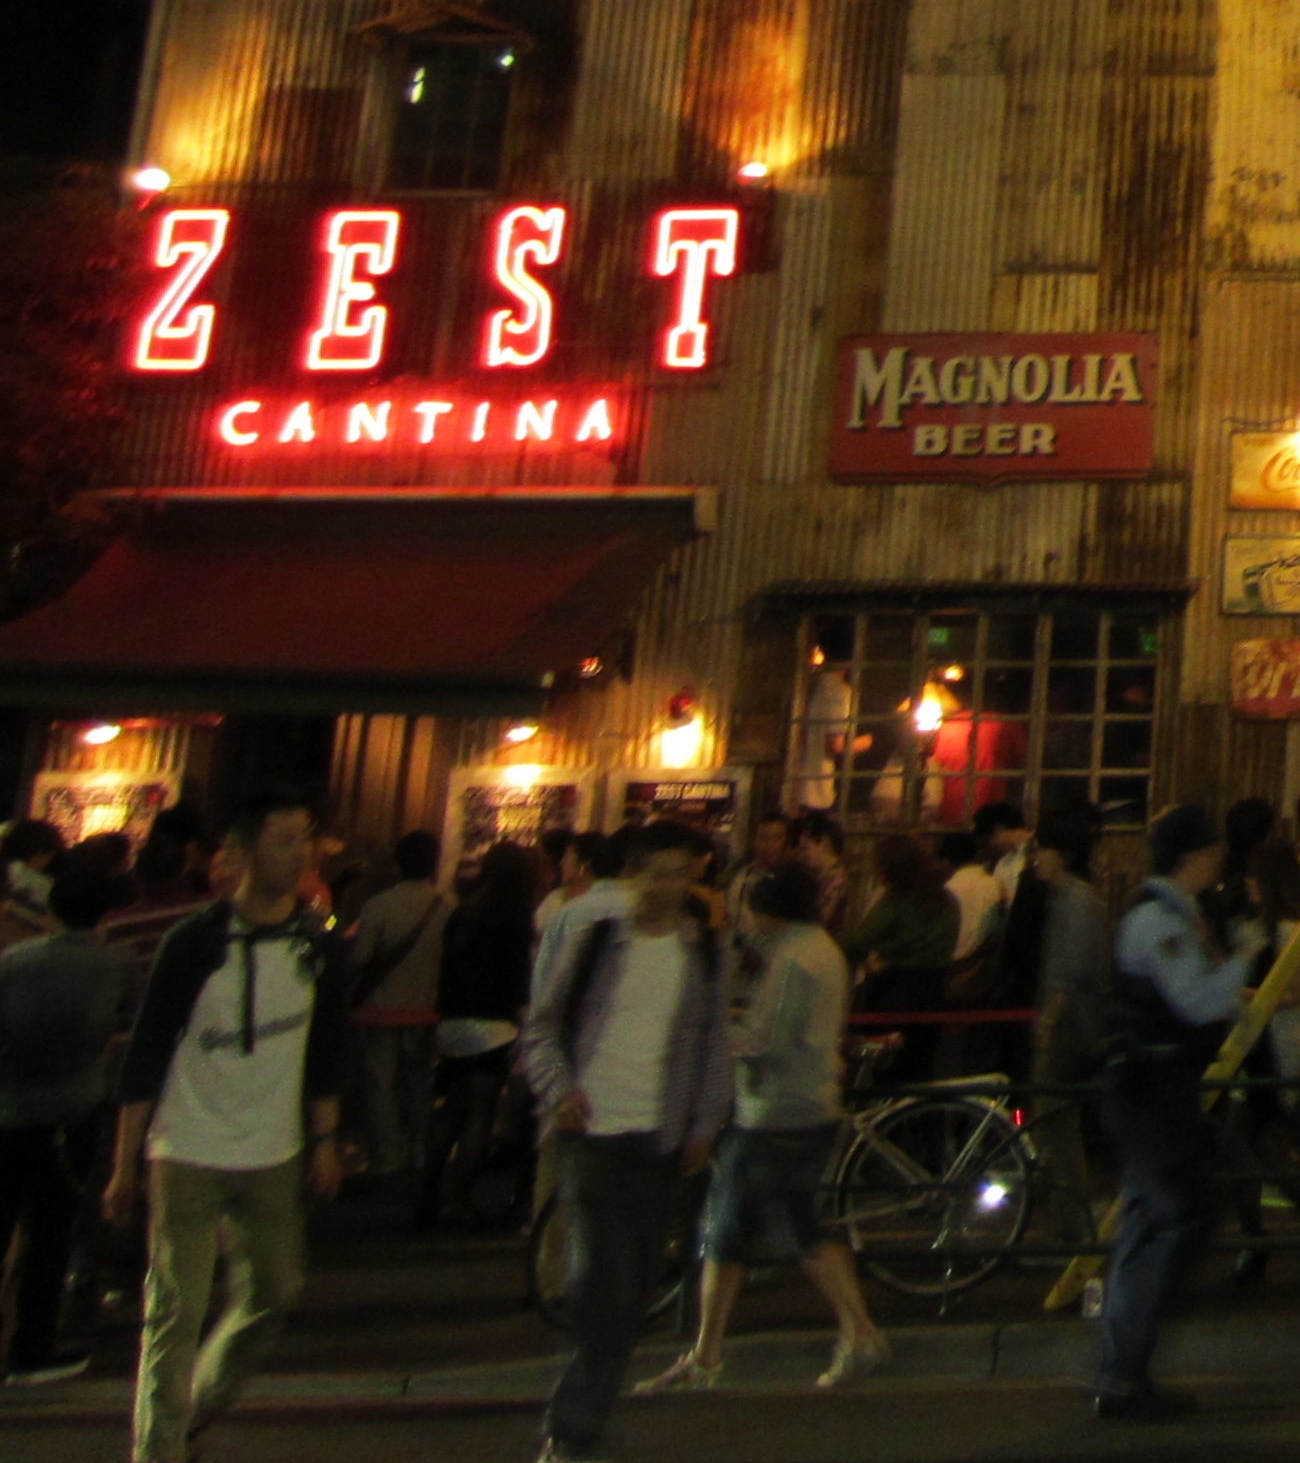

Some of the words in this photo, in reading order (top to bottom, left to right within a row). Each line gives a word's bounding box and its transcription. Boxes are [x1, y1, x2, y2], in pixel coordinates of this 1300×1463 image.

[133, 206, 740, 371] ZEST
[846, 346, 1143, 430] MAGNOLIA
[219, 398, 613, 446] CANTINA
[913, 422, 1057, 458] BEER
